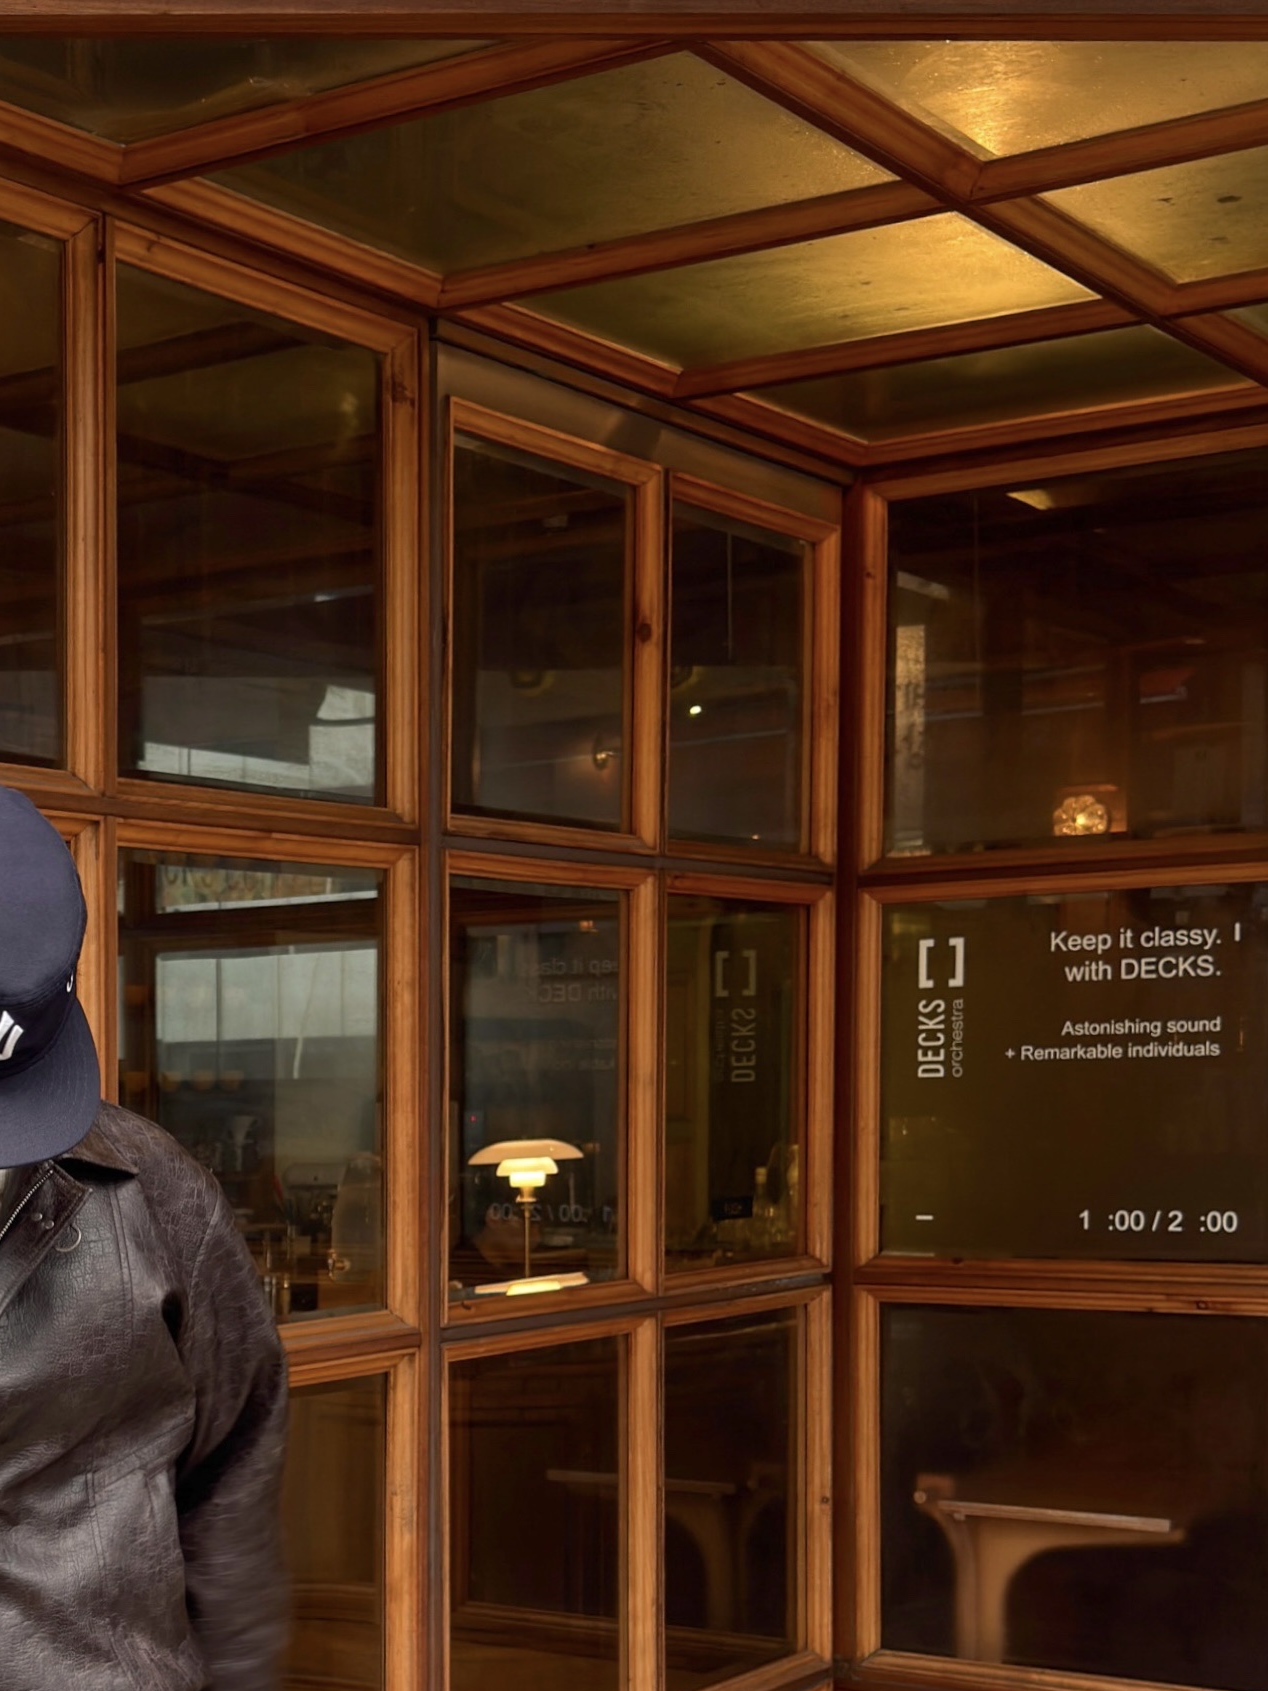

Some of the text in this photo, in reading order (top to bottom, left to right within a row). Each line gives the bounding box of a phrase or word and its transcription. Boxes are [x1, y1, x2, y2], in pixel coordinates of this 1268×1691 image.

[1050, 925, 1222, 955] Keep it classy.
[1064, 955, 1222, 982] with DECKS.
[917, 998, 945, 1079] DECKS
[949, 998, 964, 1079] orchestra
[1061, 1015, 1222, 1038] Astonishing sound
[1020, 1042, 1123, 1061] Remarkable
[1128, 1040, 1221, 1059] individuals
